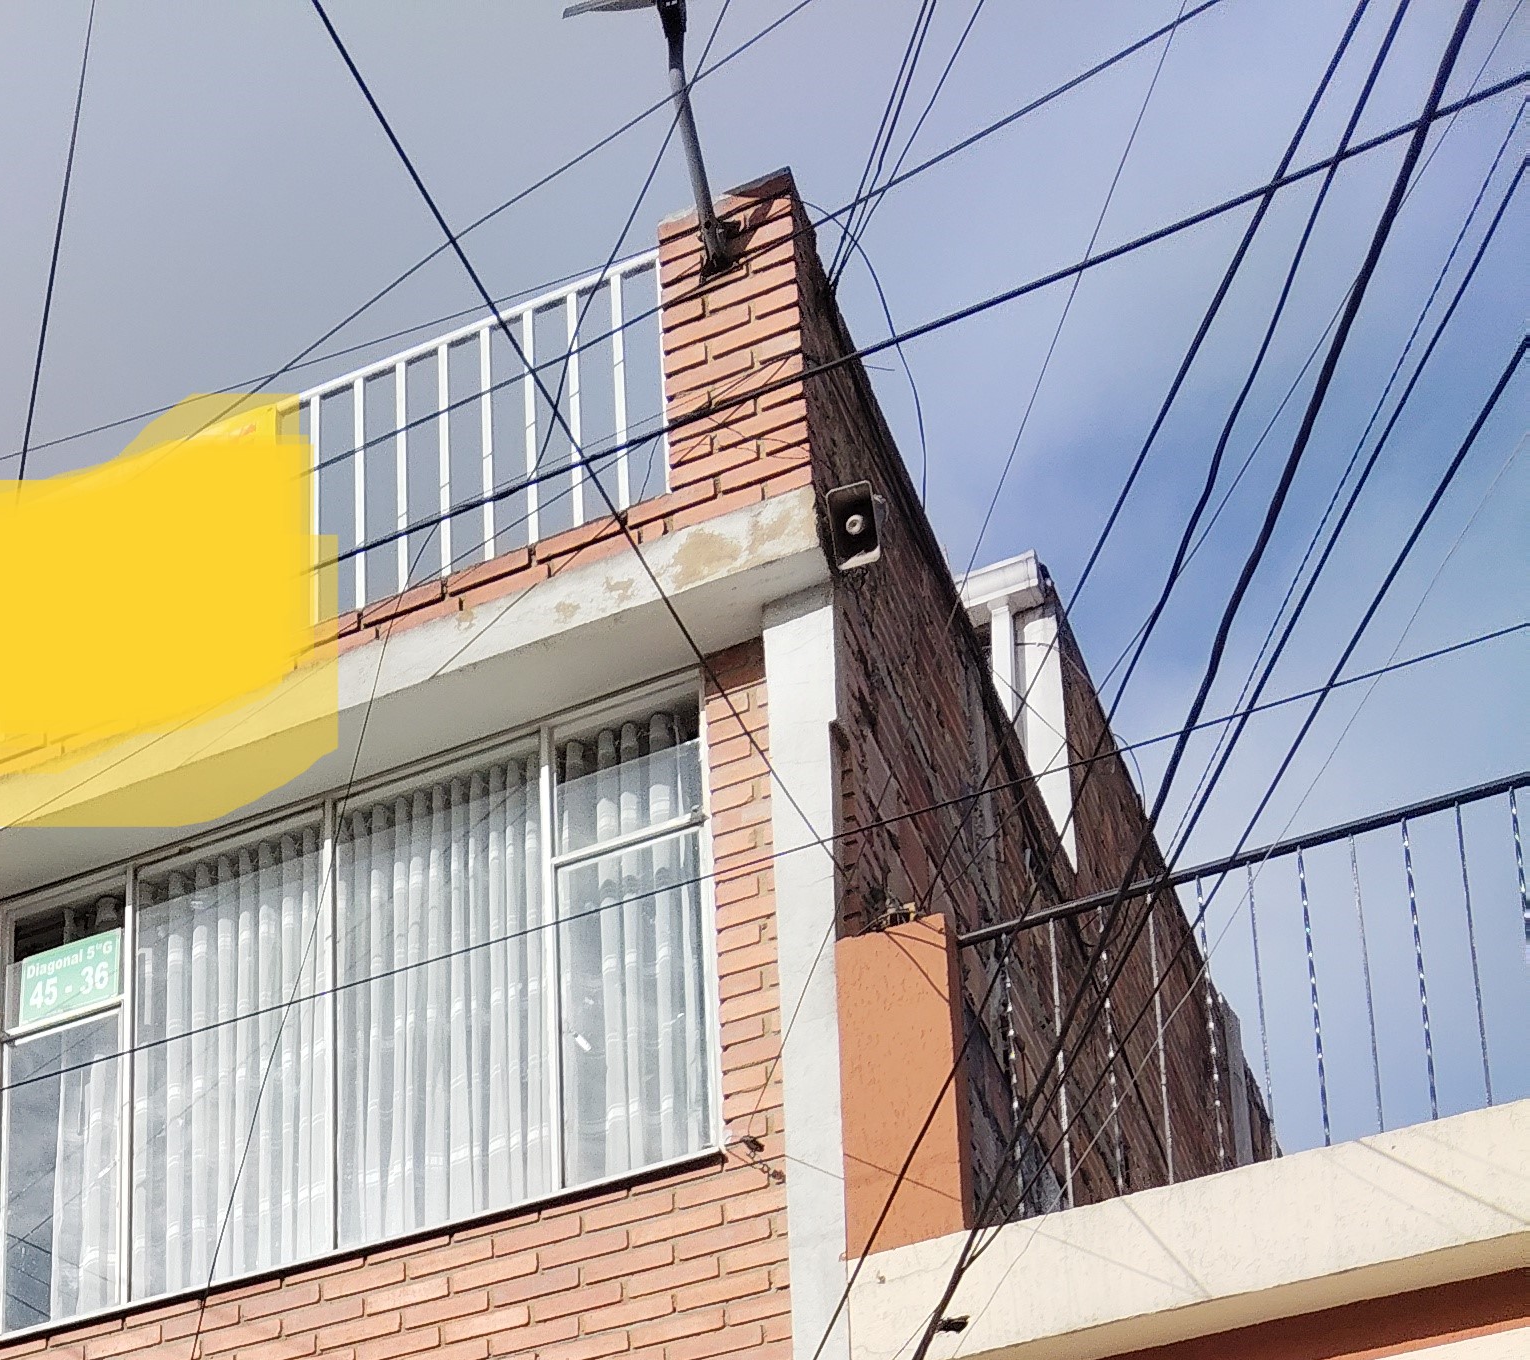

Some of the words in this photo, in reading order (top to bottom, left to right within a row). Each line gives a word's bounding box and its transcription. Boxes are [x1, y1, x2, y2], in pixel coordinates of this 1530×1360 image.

[27, 949, 83, 979] Diagonal
[30, 976, 58, 1009] 45
[79, 961, 109, 995] 36
